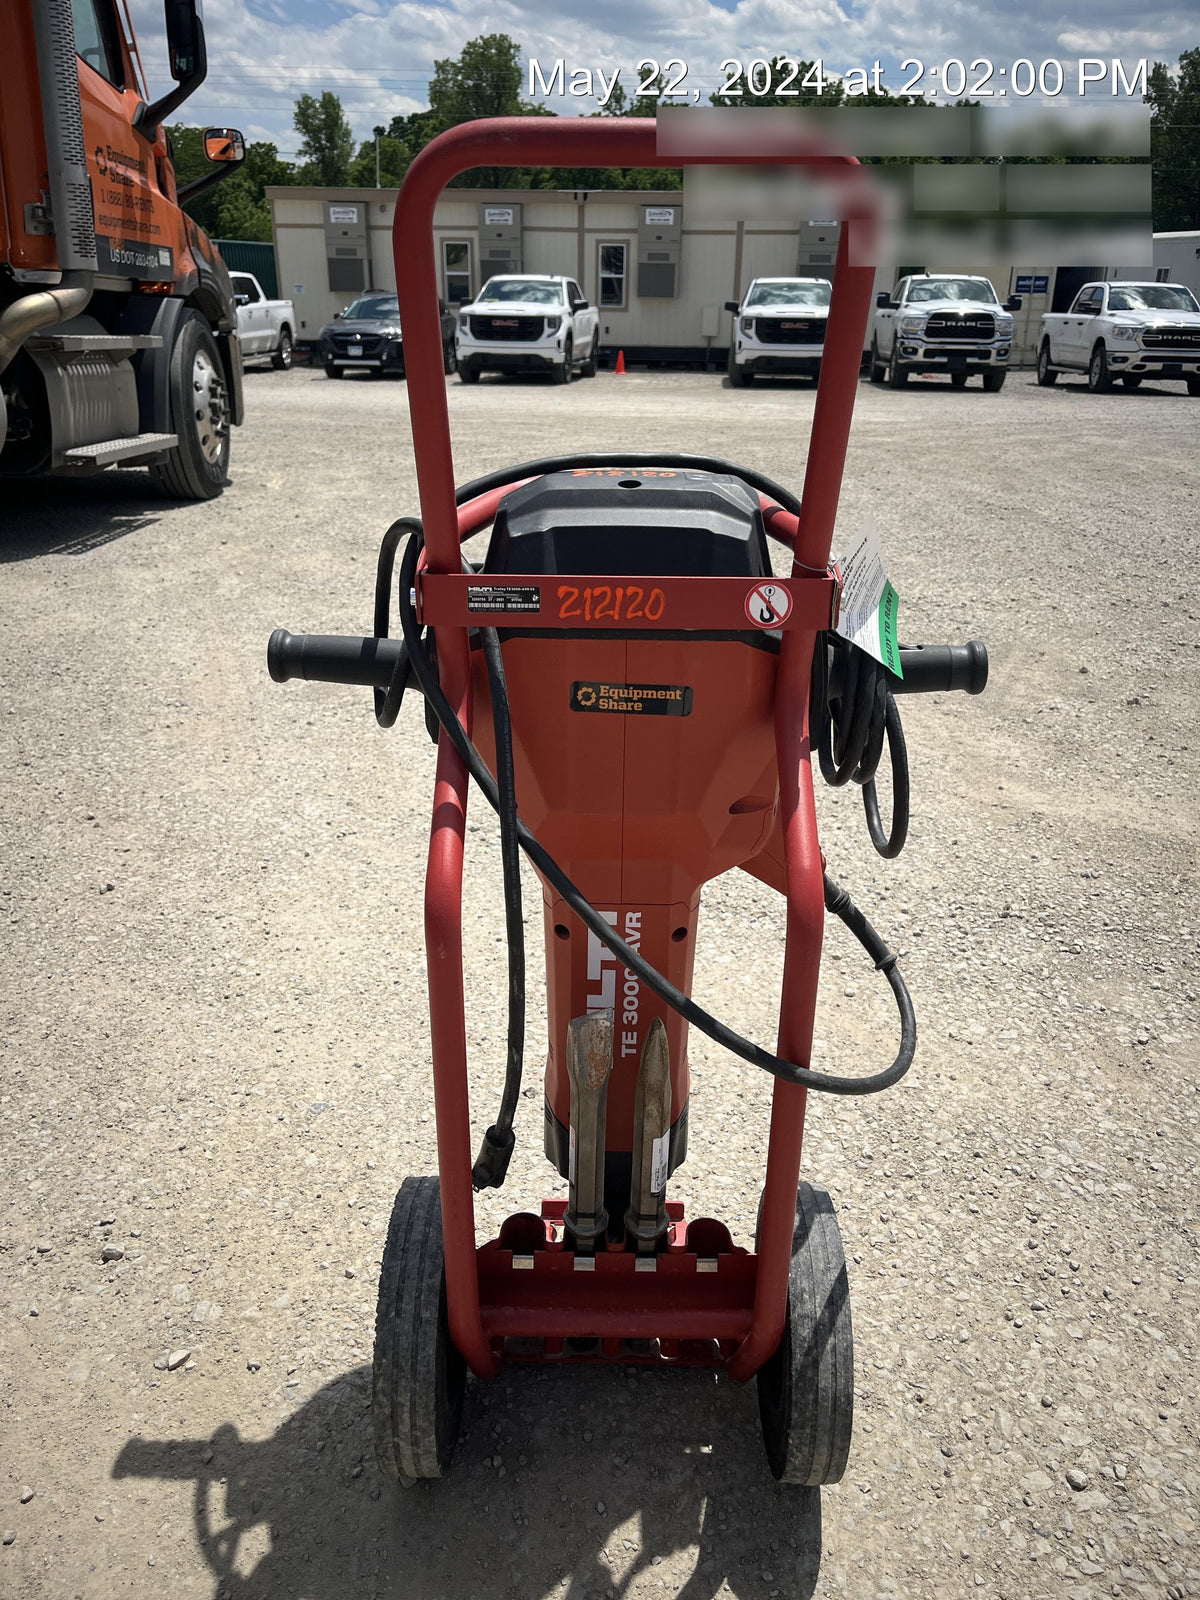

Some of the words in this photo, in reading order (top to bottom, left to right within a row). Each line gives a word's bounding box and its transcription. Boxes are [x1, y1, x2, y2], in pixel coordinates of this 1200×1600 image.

[491, 319, 520, 327] GMC
[557, 585, 666, 621] 212120
[884, 588, 894, 616] RENT
[884, 620, 892, 634] TO
[884, 637, 896, 671] READY
[599, 685, 682, 701] Equipment
[599, 699, 643, 711] Share
[621, 1032, 638, 1058] TE
